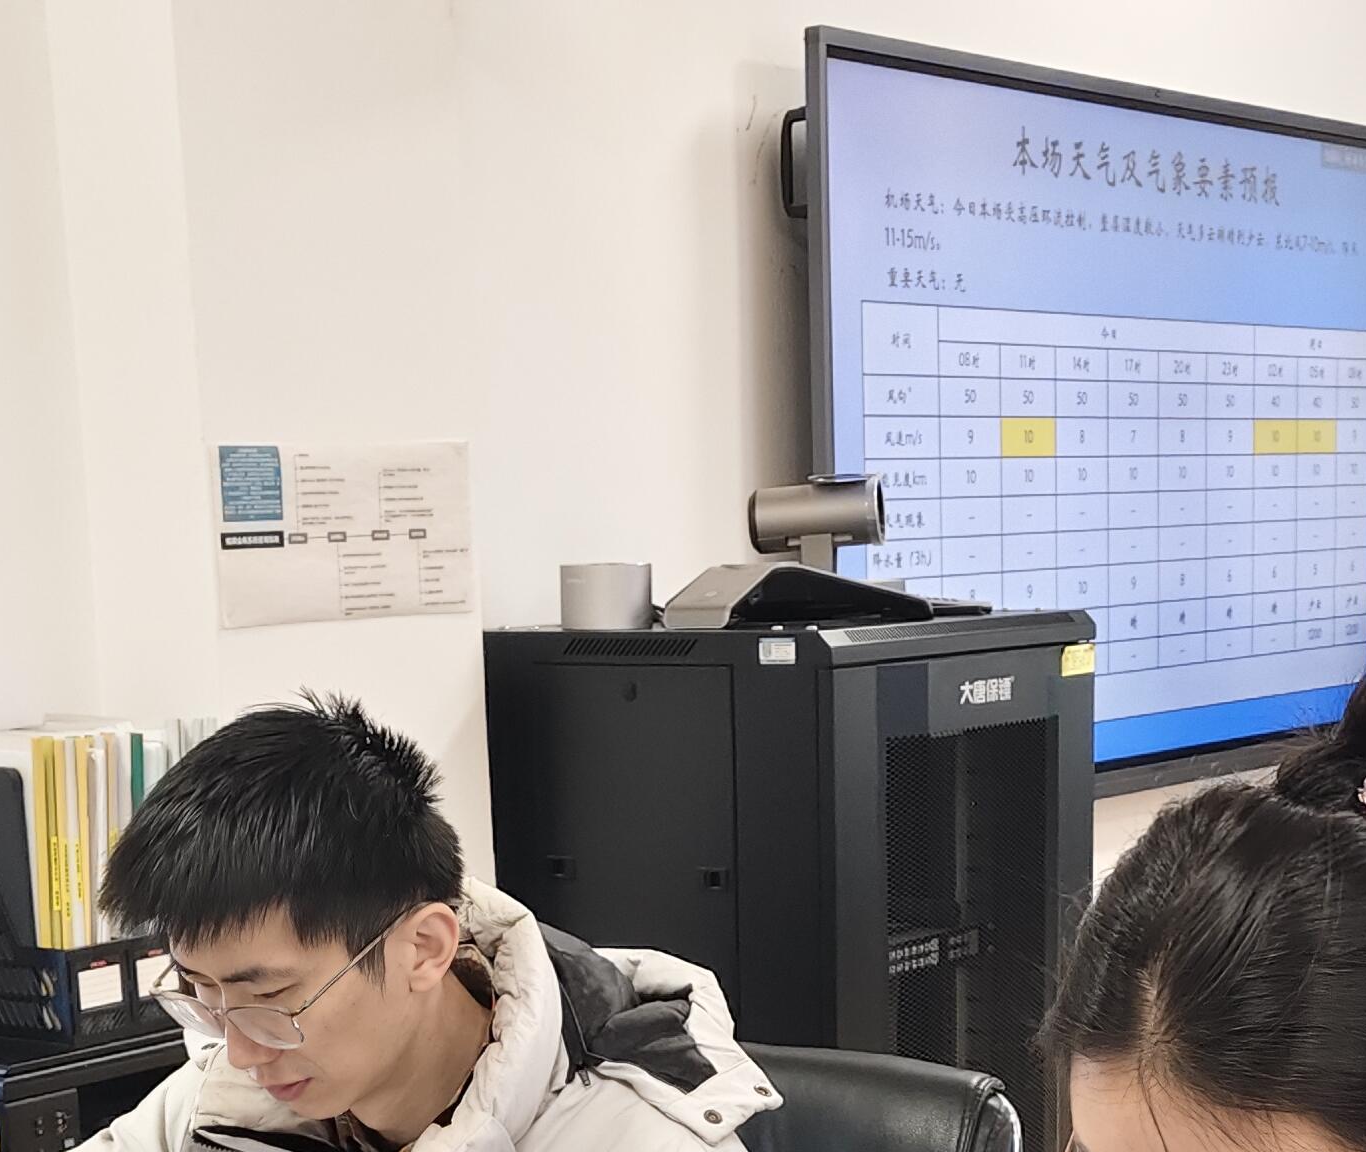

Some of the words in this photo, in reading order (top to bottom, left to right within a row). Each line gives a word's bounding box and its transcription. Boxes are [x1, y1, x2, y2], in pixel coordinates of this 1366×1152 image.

[1013, 126, 1280, 206] 本场天气及气象要素预报
[958, 353, 980, 368] 08时
